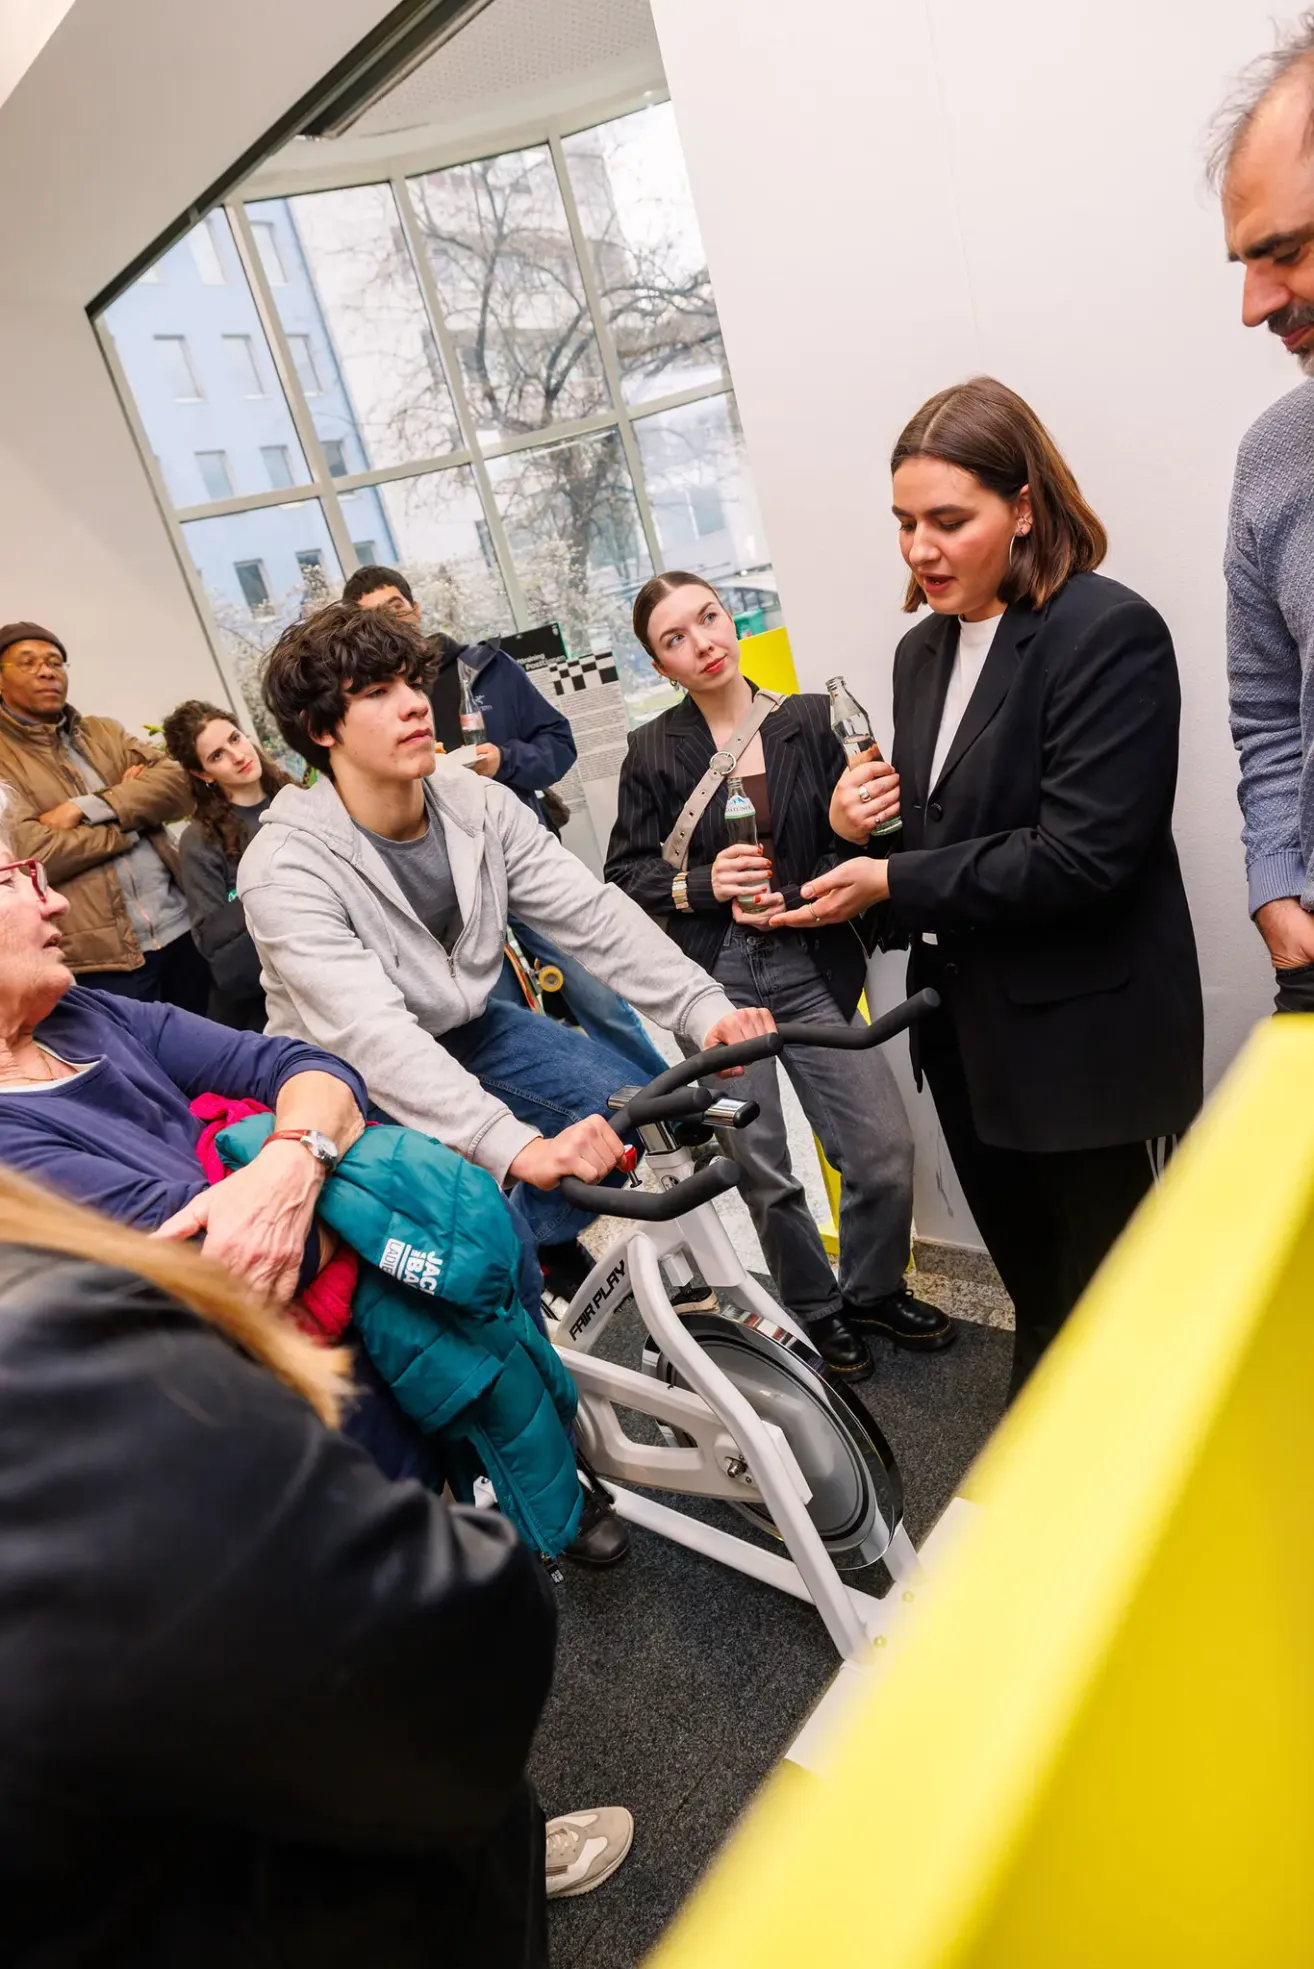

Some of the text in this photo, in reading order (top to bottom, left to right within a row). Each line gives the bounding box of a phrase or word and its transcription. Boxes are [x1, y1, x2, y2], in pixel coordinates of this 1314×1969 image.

[403, 1257, 425, 1289] BA
[569, 1259, 626, 1342] FAIR PLAY
